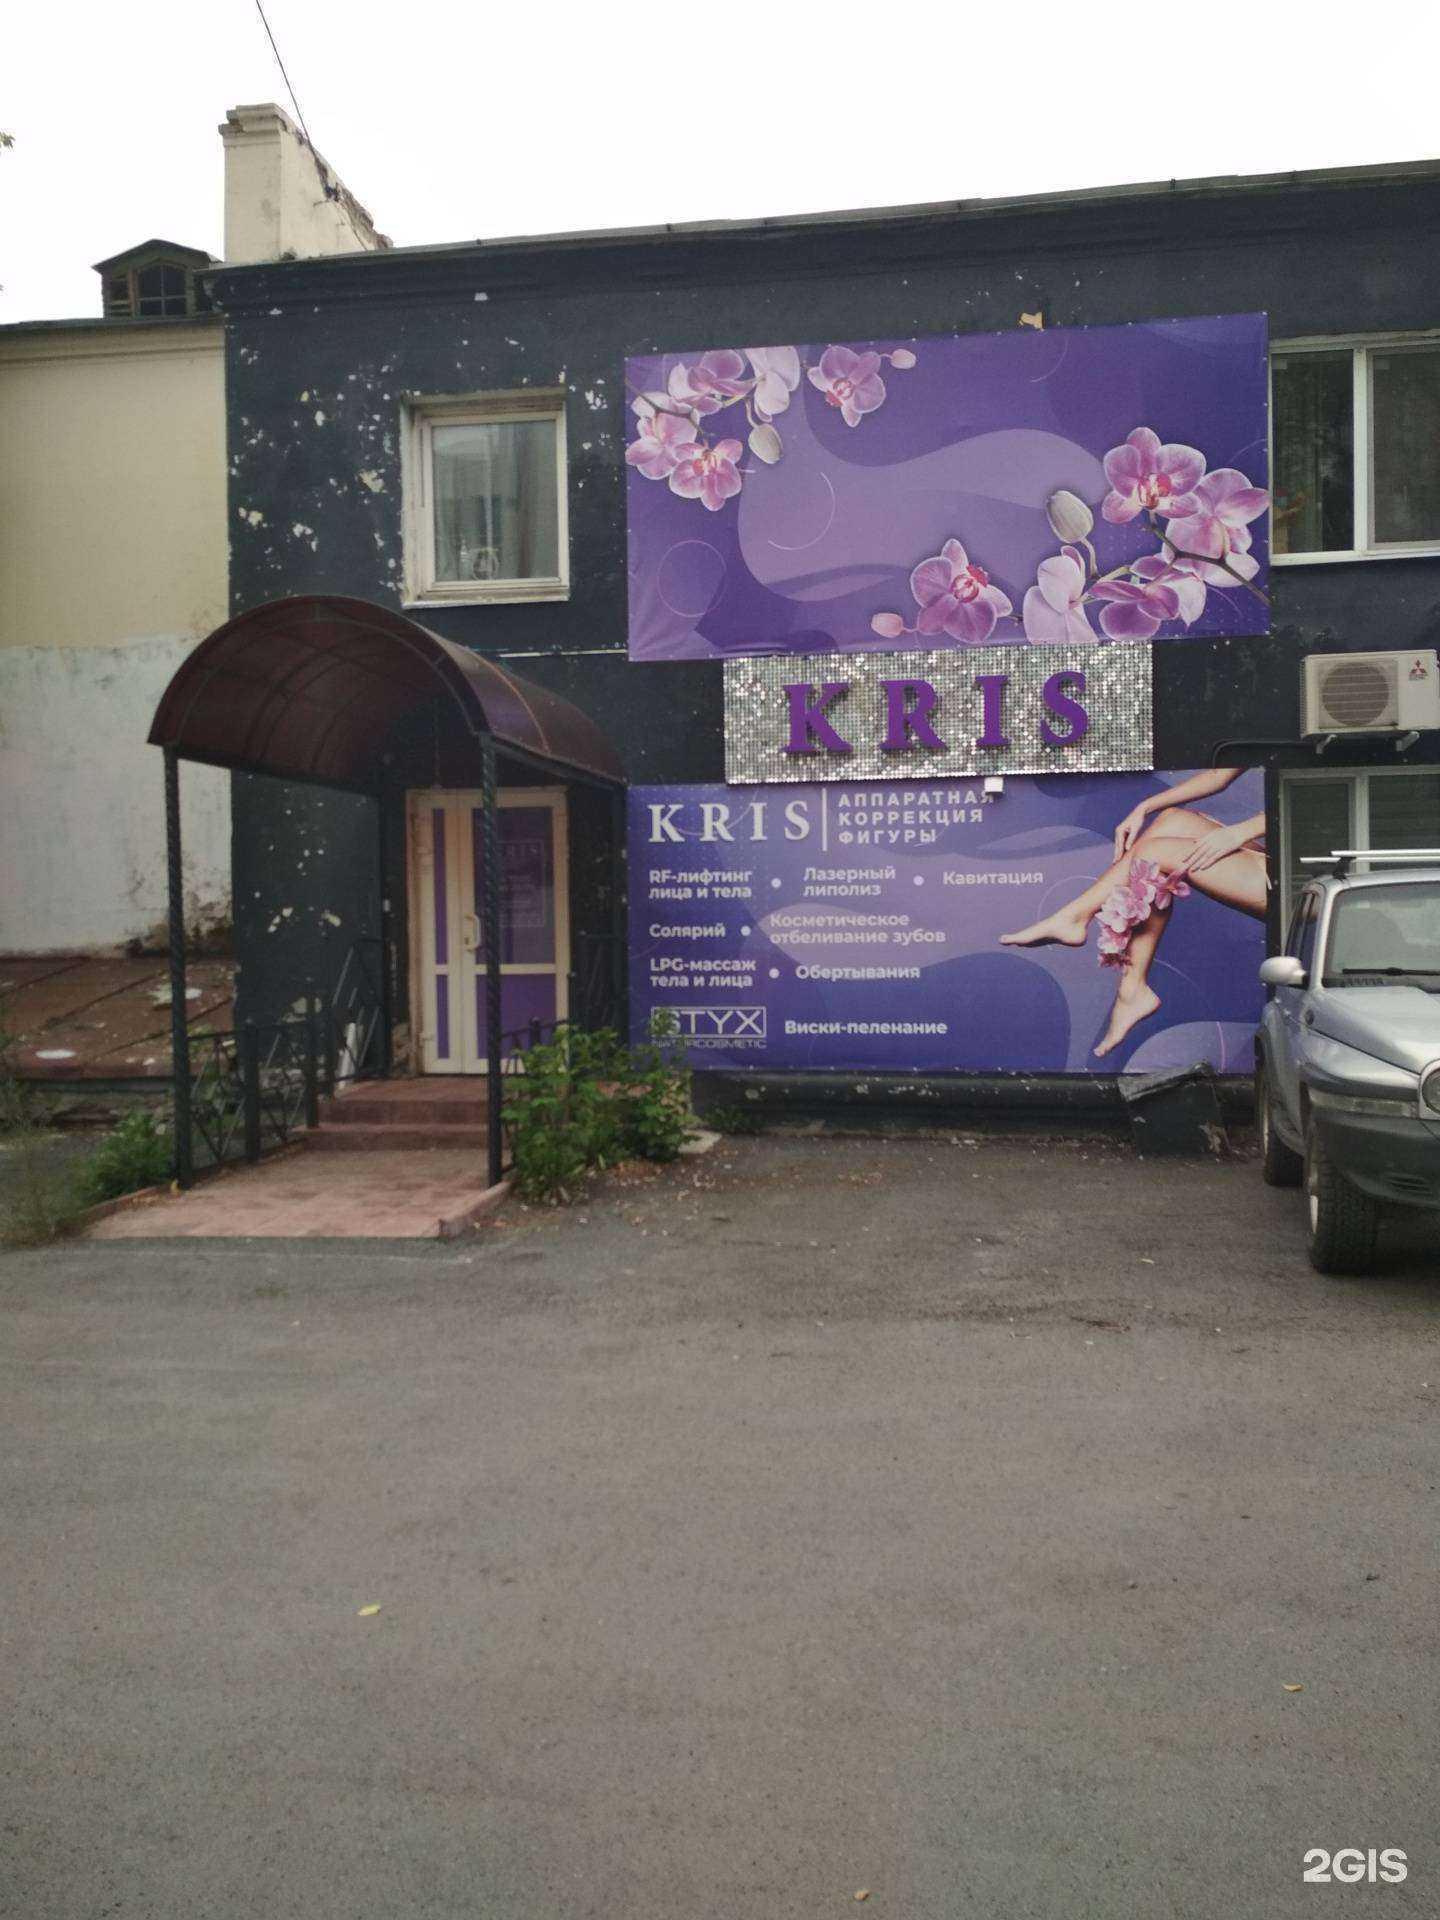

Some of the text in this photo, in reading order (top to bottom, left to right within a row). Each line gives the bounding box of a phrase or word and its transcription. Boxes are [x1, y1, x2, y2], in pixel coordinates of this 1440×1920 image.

[780, 671, 1089, 754] KRIS
[648, 800, 810, 842] KRIS
[837, 809, 984, 826] КОРРЕКЦИЯ
[837, 829, 936, 844] ФИГУРЫ
[649, 869, 752, 885] RF-лифтинг
[803, 865, 896, 883] Лазерный
[943, 872, 1044, 885] Кавитация
[649, 886, 752, 899] лица и тела
[803, 885, 881, 896] липолиз
[770, 914, 910, 927] Косметическое
[649, 923, 726, 940] Солярий
[769, 928, 946, 946] отбеливание зубов
[650, 958, 757, 972] LPG-массаж
[795, 965, 921, 982] Обертывания
[650, 975, 753, 988] тела и лица
[784, 1020, 948, 1034] Виски-пеленание
